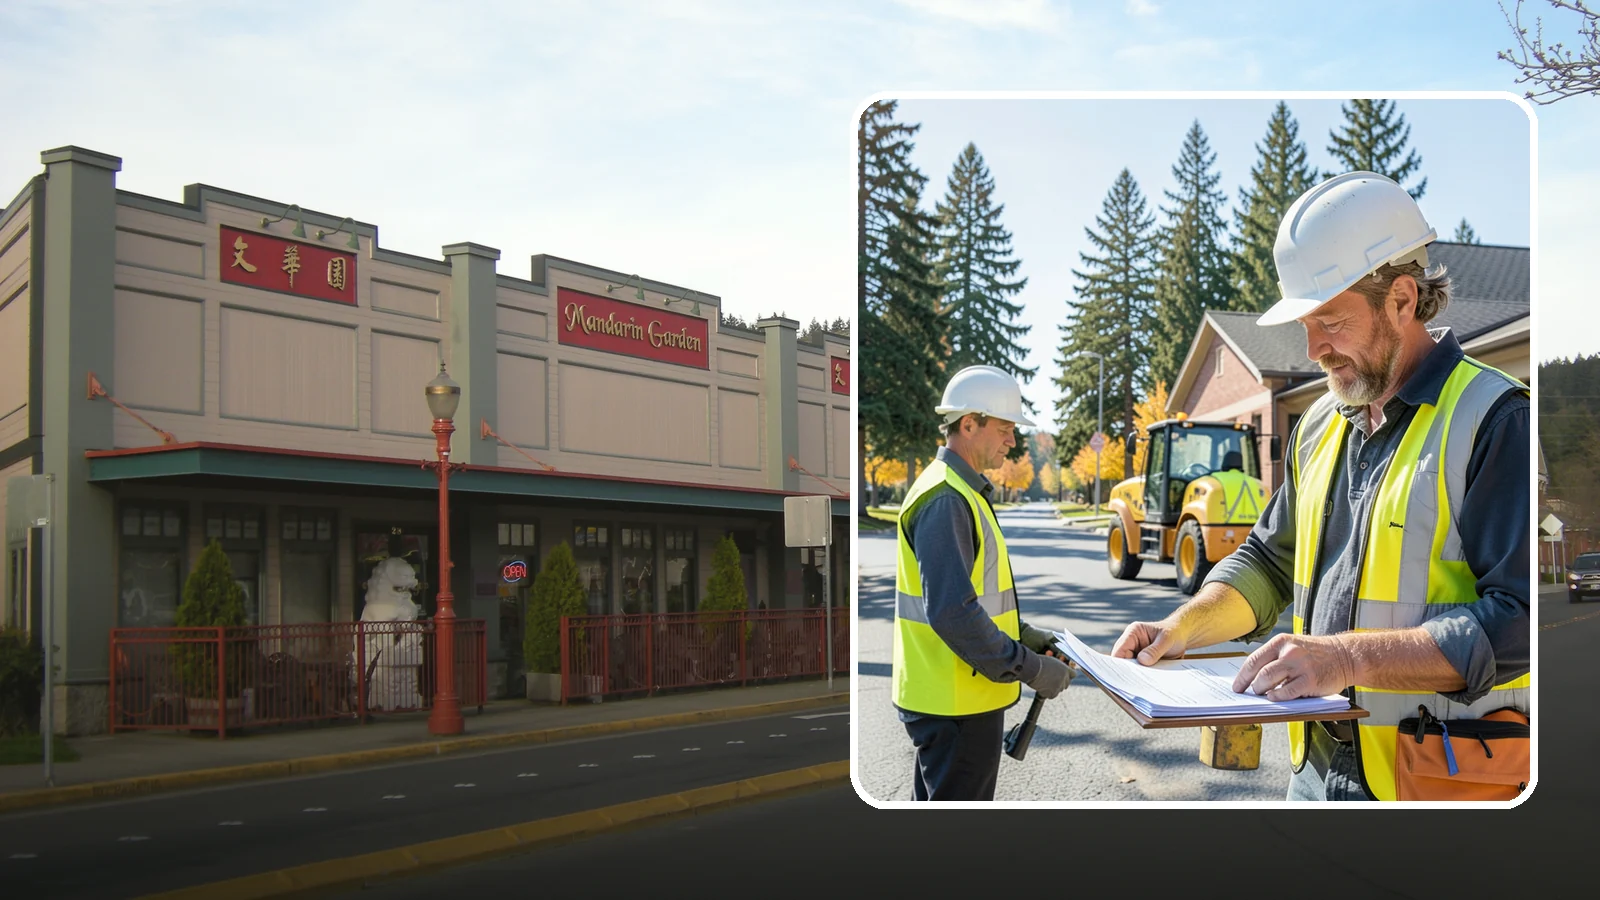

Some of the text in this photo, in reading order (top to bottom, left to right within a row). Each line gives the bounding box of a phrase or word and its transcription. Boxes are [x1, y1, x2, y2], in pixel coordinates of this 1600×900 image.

[231, 236, 346, 291] 文華園
[564, 302, 702, 352] Mandarin Garden
[834, 363, 847, 386] 文
[391, 526, 402, 536] 28
[503, 565, 526, 577] OPEN
